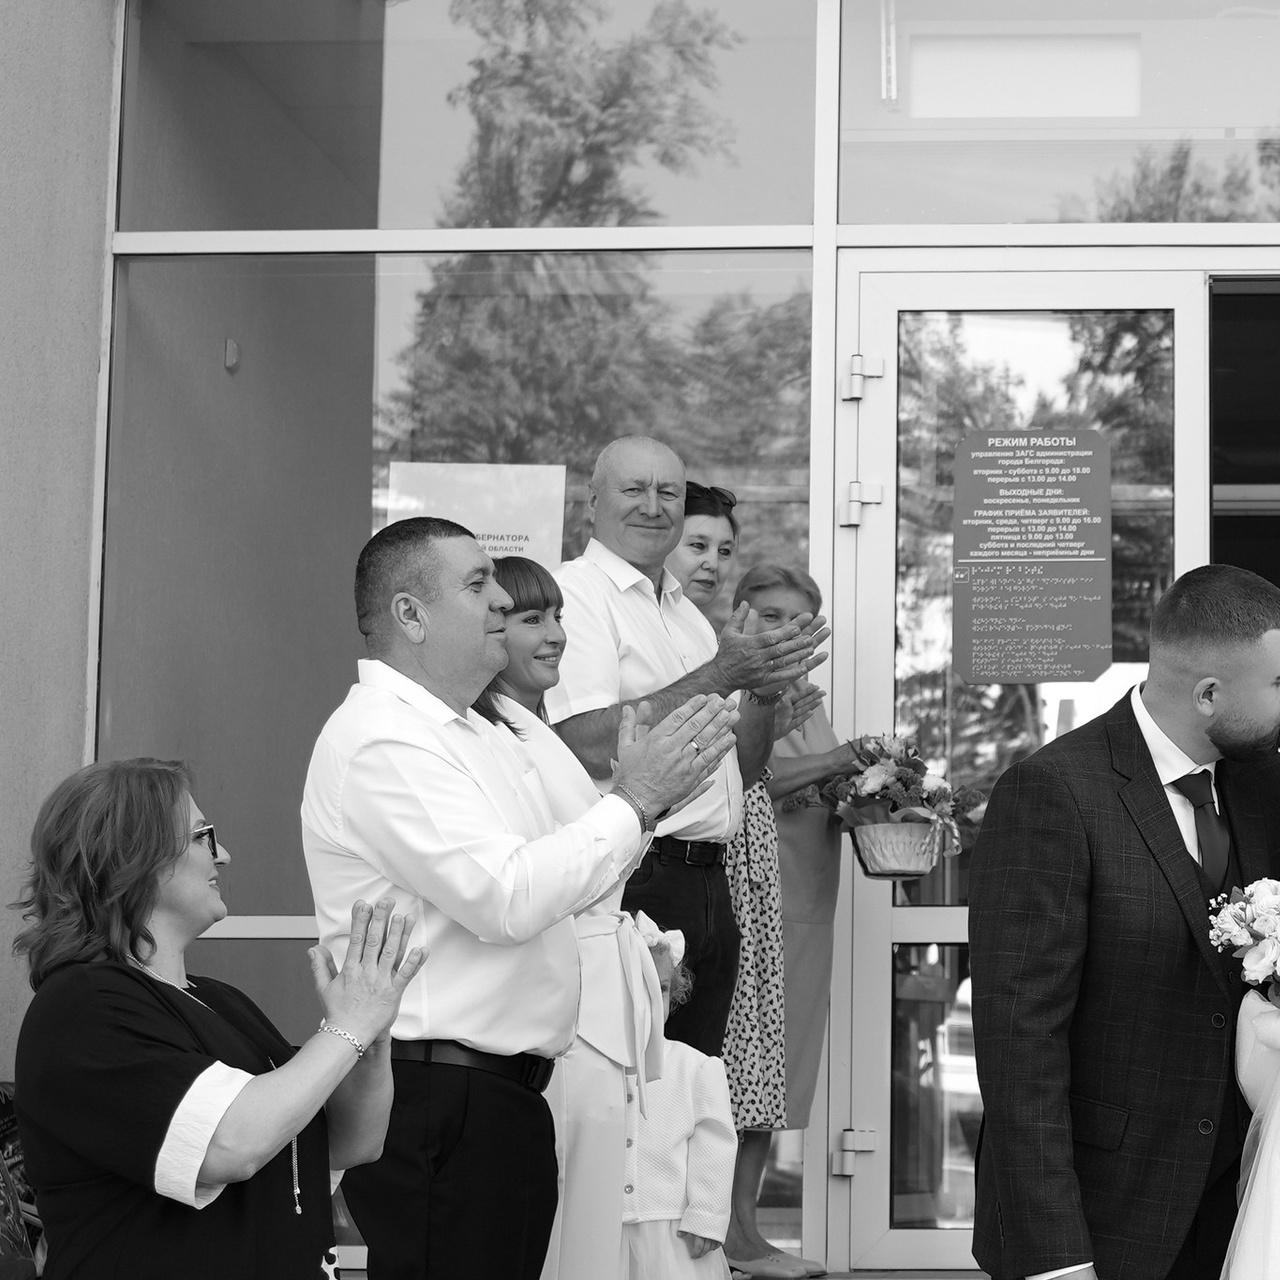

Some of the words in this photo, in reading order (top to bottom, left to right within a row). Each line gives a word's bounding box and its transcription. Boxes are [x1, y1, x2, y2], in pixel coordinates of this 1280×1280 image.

[988, 438, 1027, 447] РЕЖИМ
[1030, 437, 1076, 446] РАБОТЫ
[1016, 450, 1034, 458] ЗАГС
[1038, 508, 1090, 516] ЗАЯВИТЕЛЕЙ:
[475, 534, 530, 542] БЕРНАТОРА
